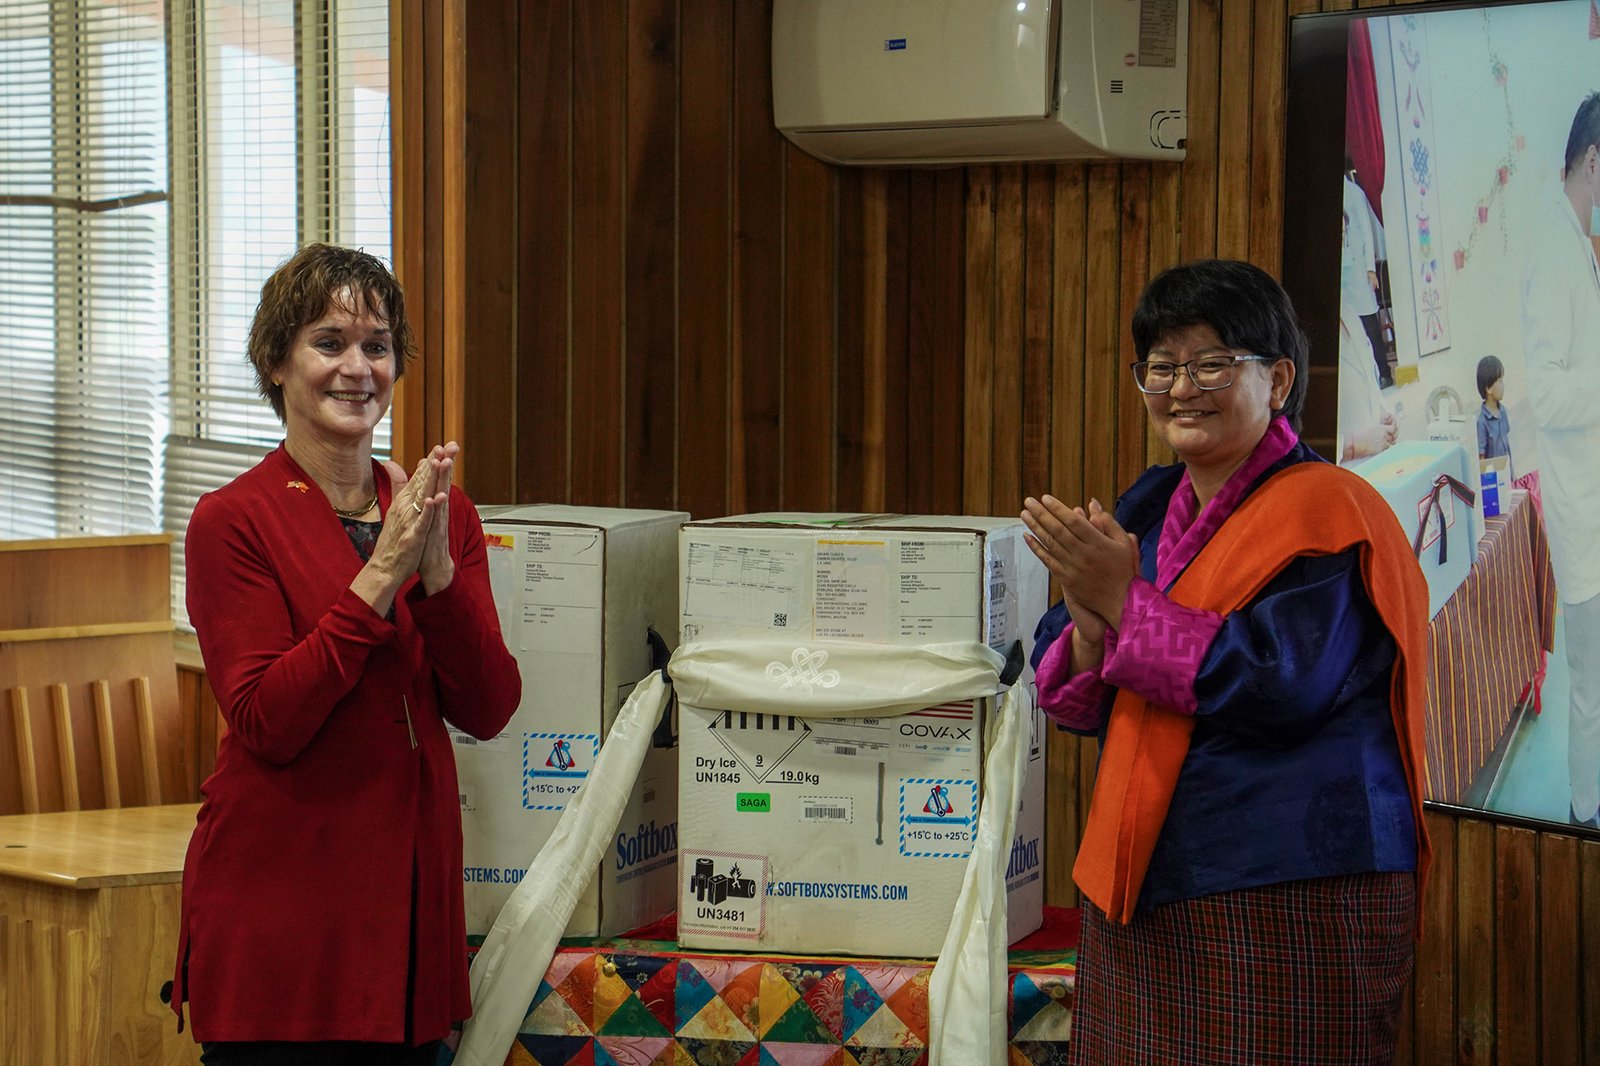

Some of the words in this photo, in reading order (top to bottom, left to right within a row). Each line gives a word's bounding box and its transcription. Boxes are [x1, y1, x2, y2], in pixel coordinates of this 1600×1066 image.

[900, 723, 972, 741] COVAX
[696, 756, 716, 769] Dry
[720, 757, 736, 768] Ice
[756, 754, 763, 765] 9
[696, 772, 741, 783] UN1845
[556, 785, 564, 793] to
[740, 798, 767, 807] SAGA
[934, 832, 942, 840] to
[616, 819, 678, 871] Softbox
[697, 907, 745, 922] UN3481
